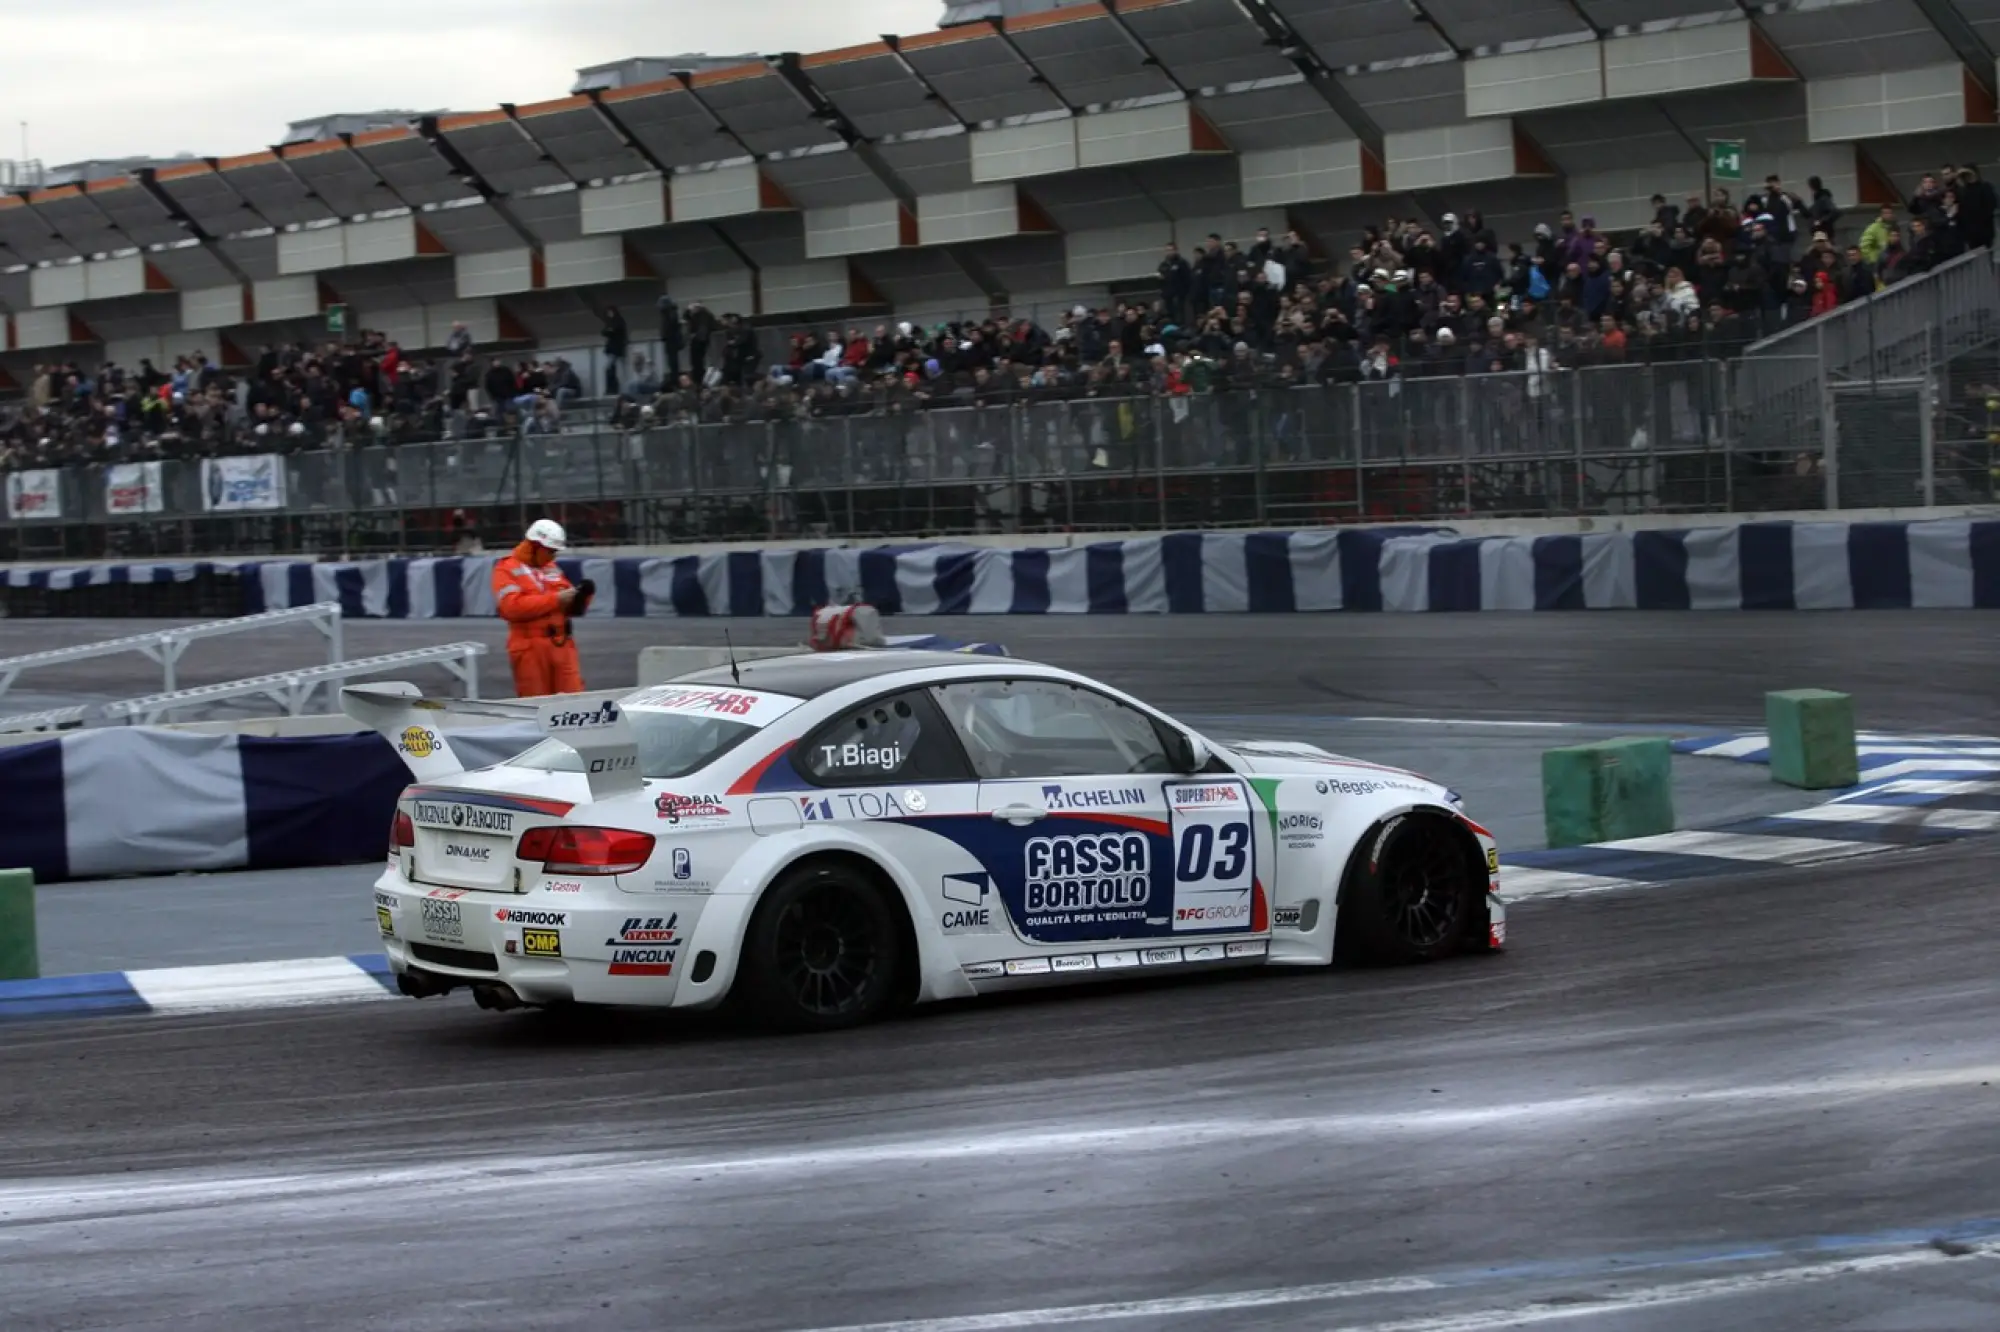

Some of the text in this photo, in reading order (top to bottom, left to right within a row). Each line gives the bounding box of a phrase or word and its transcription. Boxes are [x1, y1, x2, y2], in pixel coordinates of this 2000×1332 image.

[401, 731, 434, 743] PINCO
[398, 740, 442, 756] PALLINO
[821, 741, 900, 770] T.Biagi
[1329, 778, 1385, 795] Reggio
[1175, 787, 1239, 804] SUPERSTARS
[838, 792, 907, 819] TOA
[414, 800, 514, 832] ORIGINAL PARQUET
[1279, 814, 1323, 831] MORIGI
[446, 844, 490, 859] DINAMIC
[1027, 833, 1148, 880] FASSA
[1176, 822, 1249, 883] 03
[552, 882, 581, 892] Castrol
[1026, 877, 1148, 912] BORTOLO
[942, 909, 989, 928] CAME
[1027, 910, 1147, 926] QUALITÀ PER L'EDILIZIA
[1205, 904, 1249, 919] GROUP
[1275, 912, 1300, 923] OMP
[525, 934, 559, 950] OMP
[627, 932, 669, 940] ITALIA
[613, 950, 676, 962] LINCOLN
